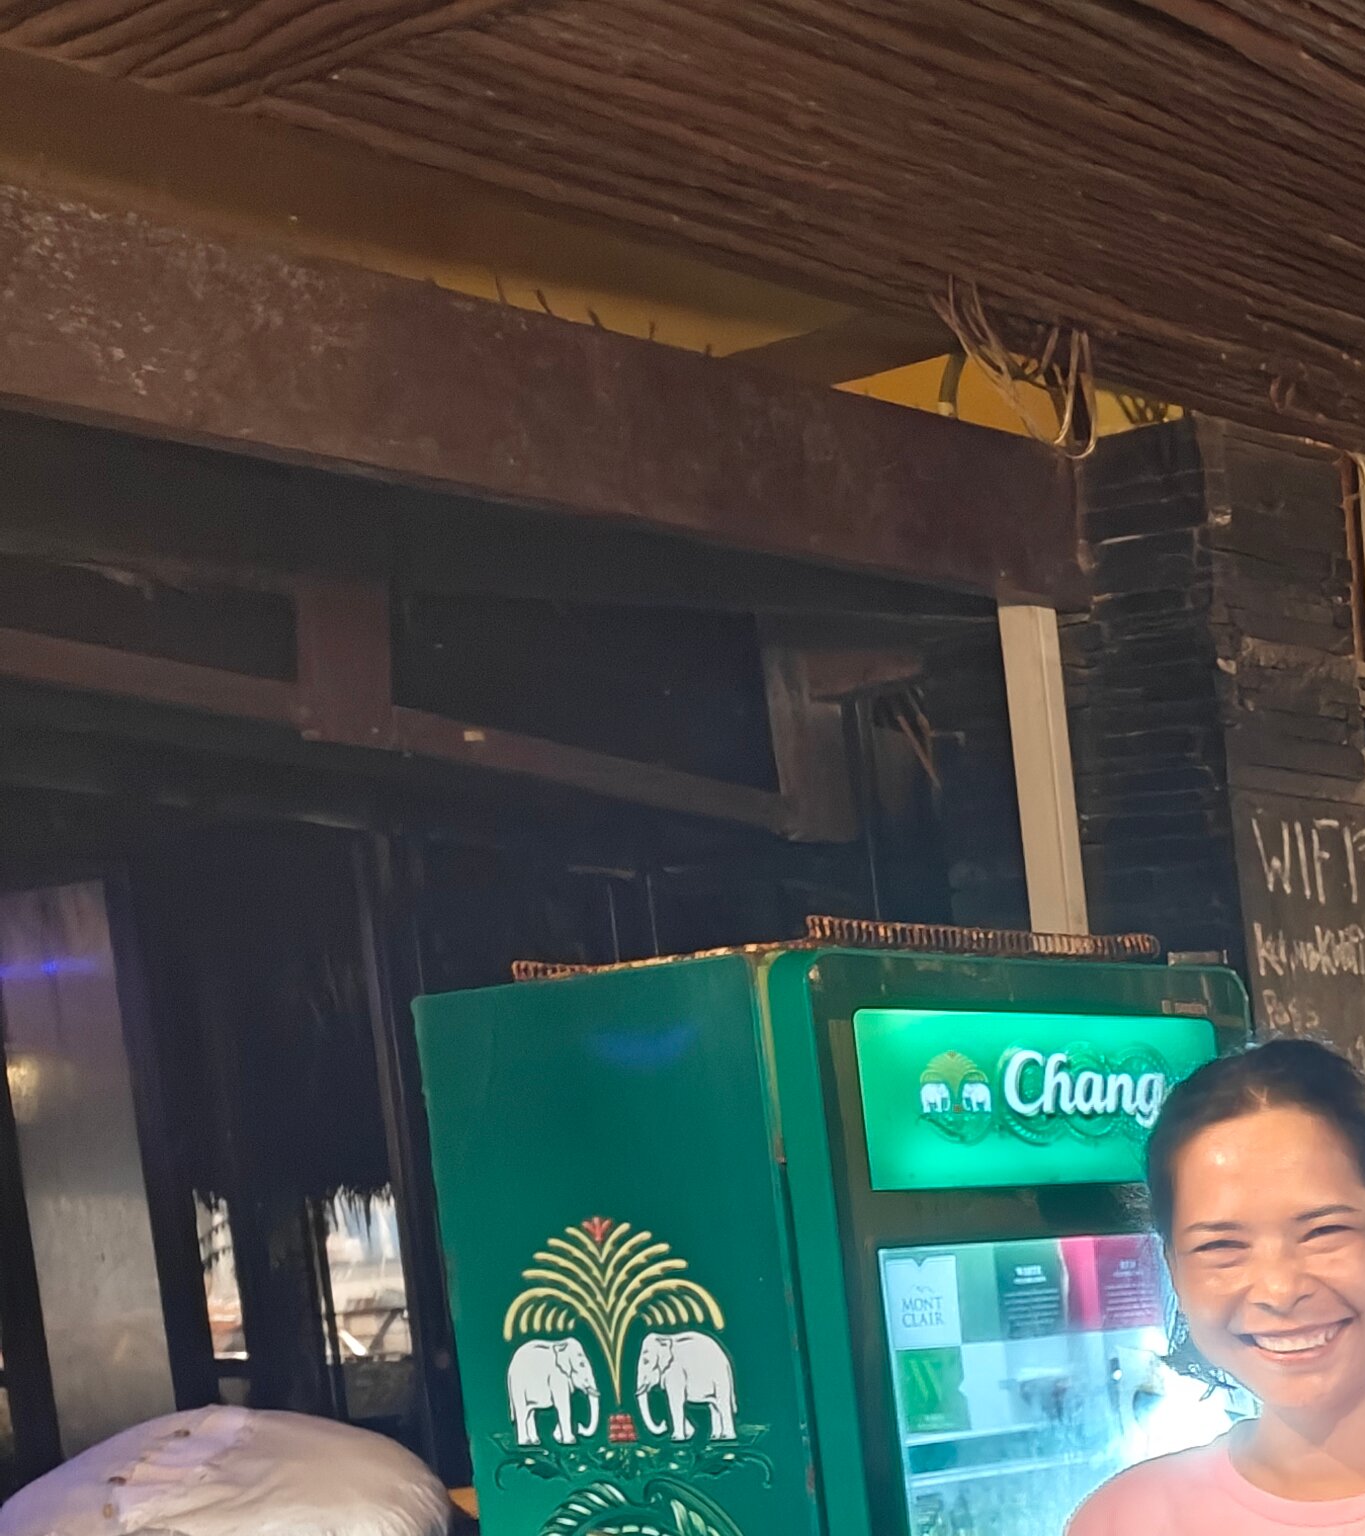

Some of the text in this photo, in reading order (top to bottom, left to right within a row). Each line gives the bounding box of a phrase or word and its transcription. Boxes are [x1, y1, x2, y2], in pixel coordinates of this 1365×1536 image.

[1003, 1050, 1165, 1129] Chang
[902, 1296, 943, 1313] MONT
[902, 1312, 944, 1328] CLAIR
